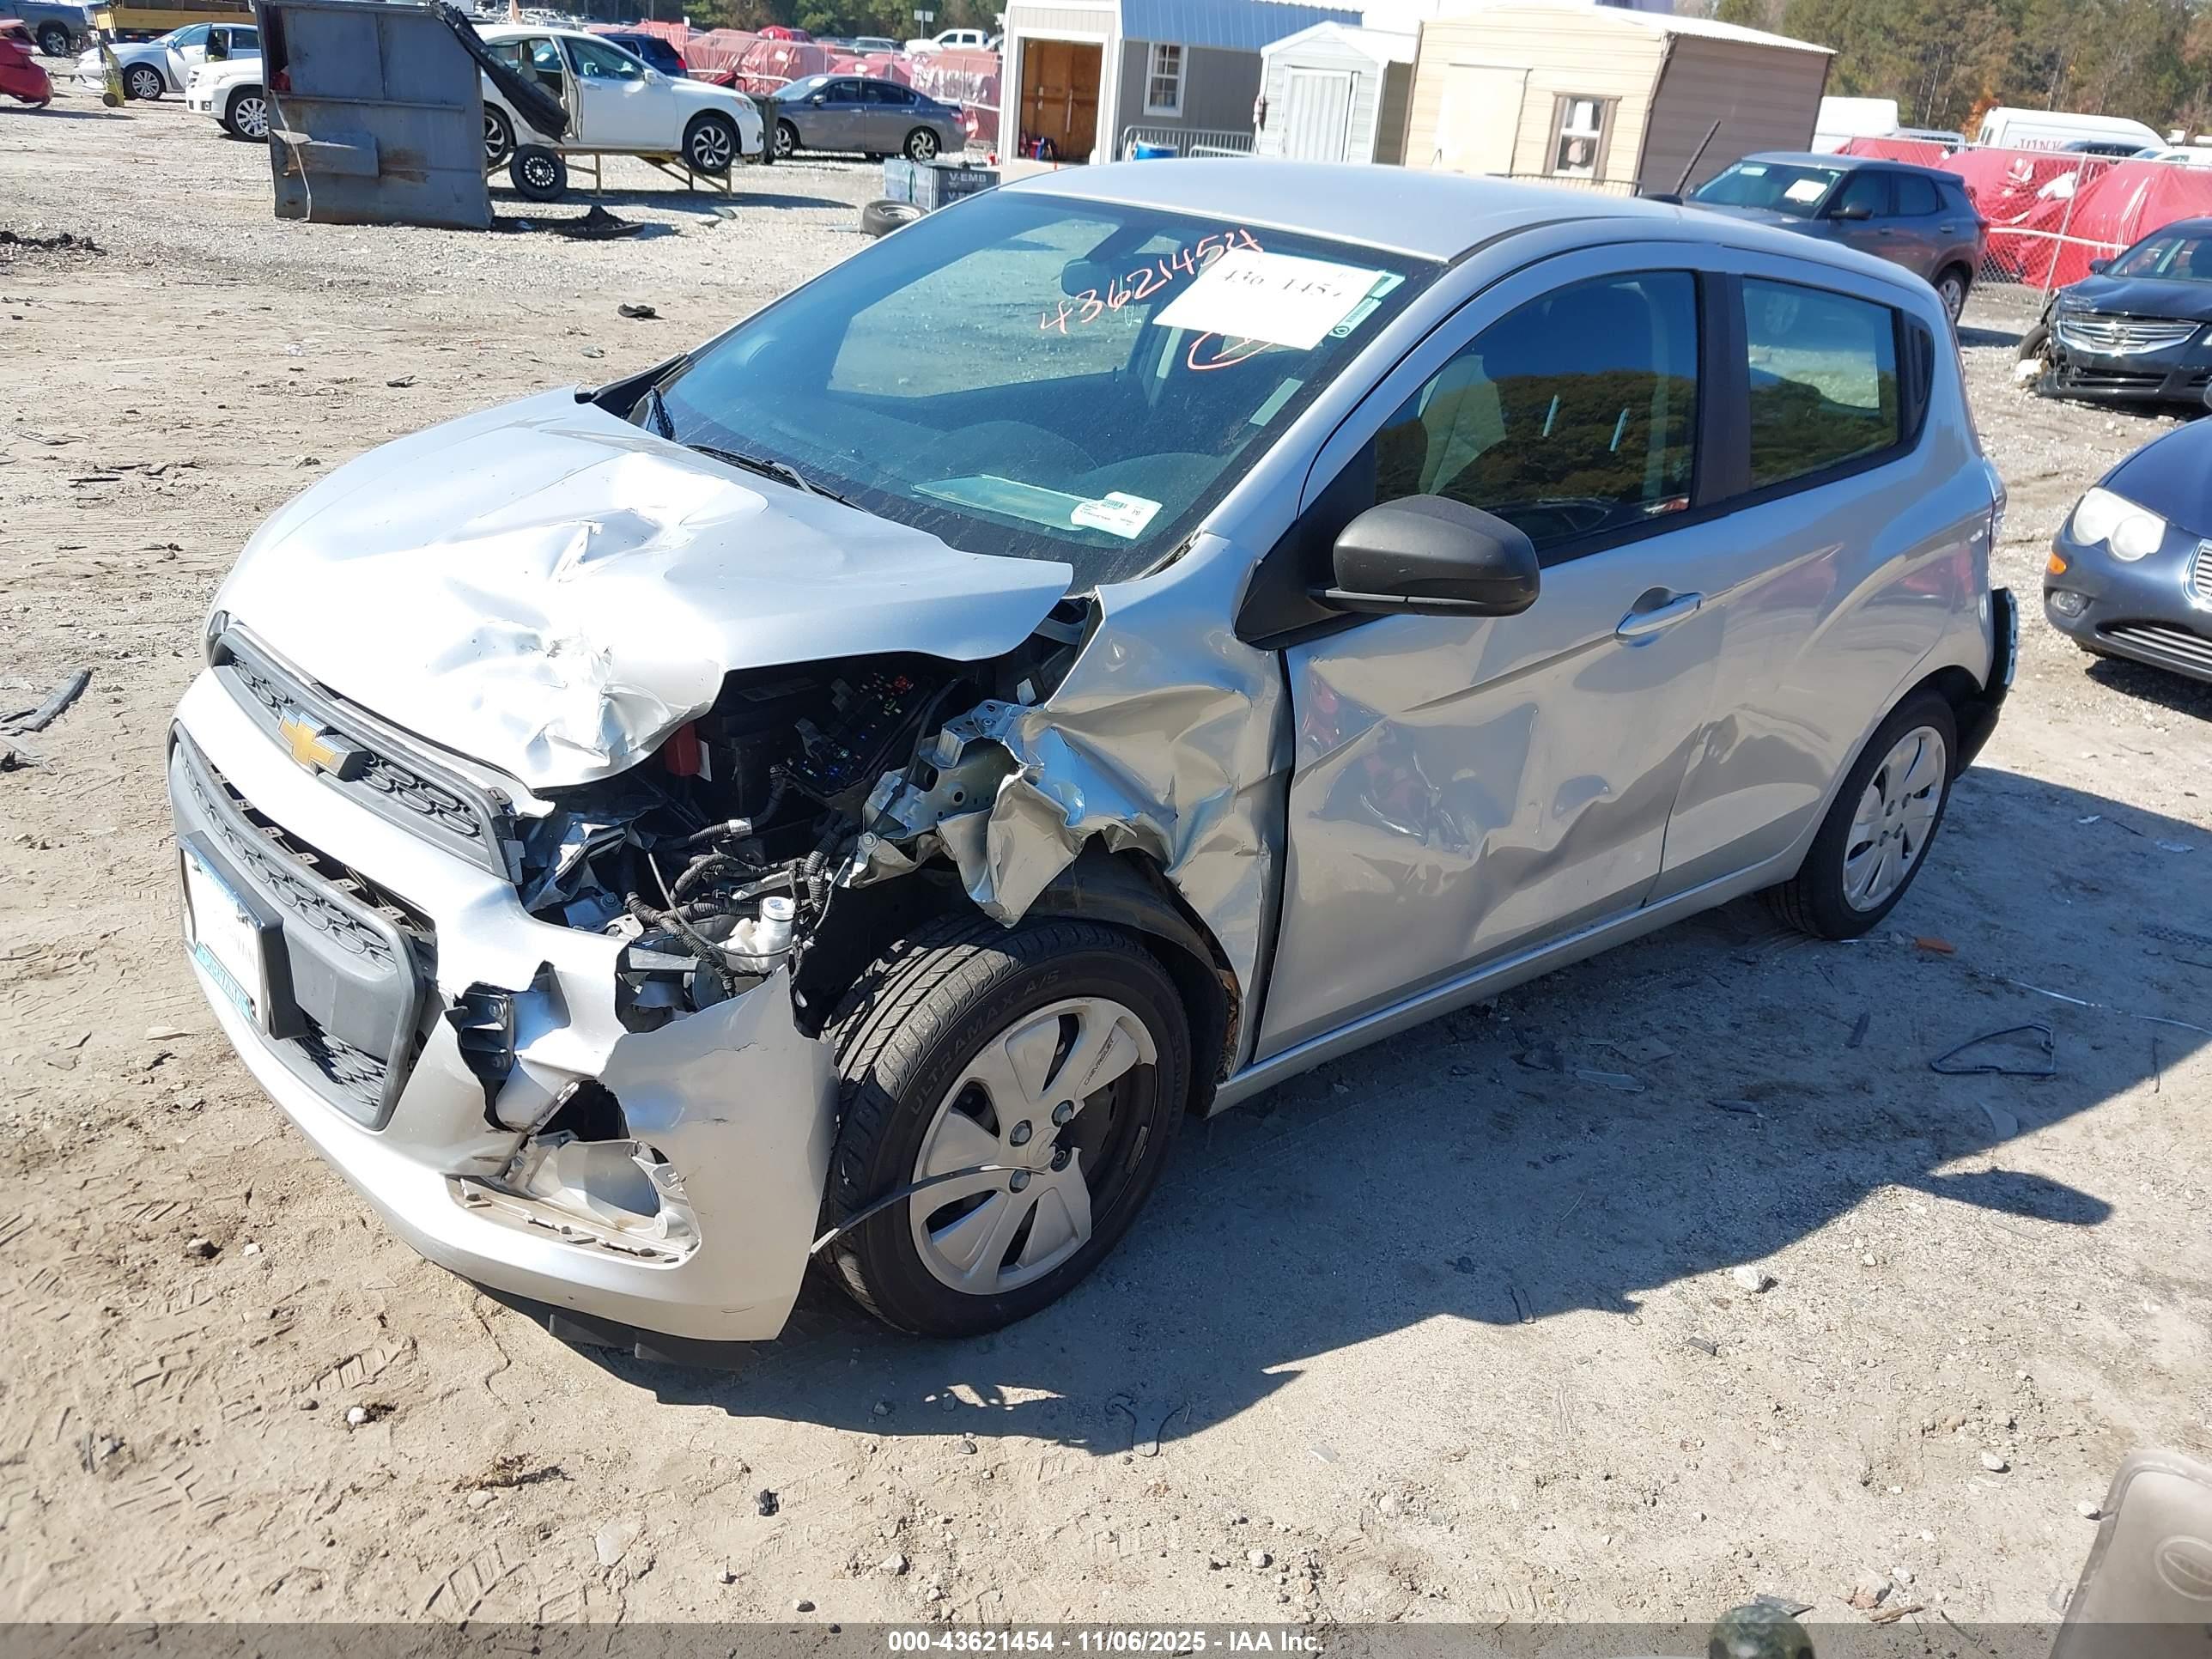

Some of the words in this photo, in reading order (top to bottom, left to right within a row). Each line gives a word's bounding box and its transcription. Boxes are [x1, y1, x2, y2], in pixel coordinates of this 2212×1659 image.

[1040, 228, 1264, 334] 43621454
[910, 991, 1017, 1115] ULTRAMAX
[1024, 970, 1059, 995] A/S
